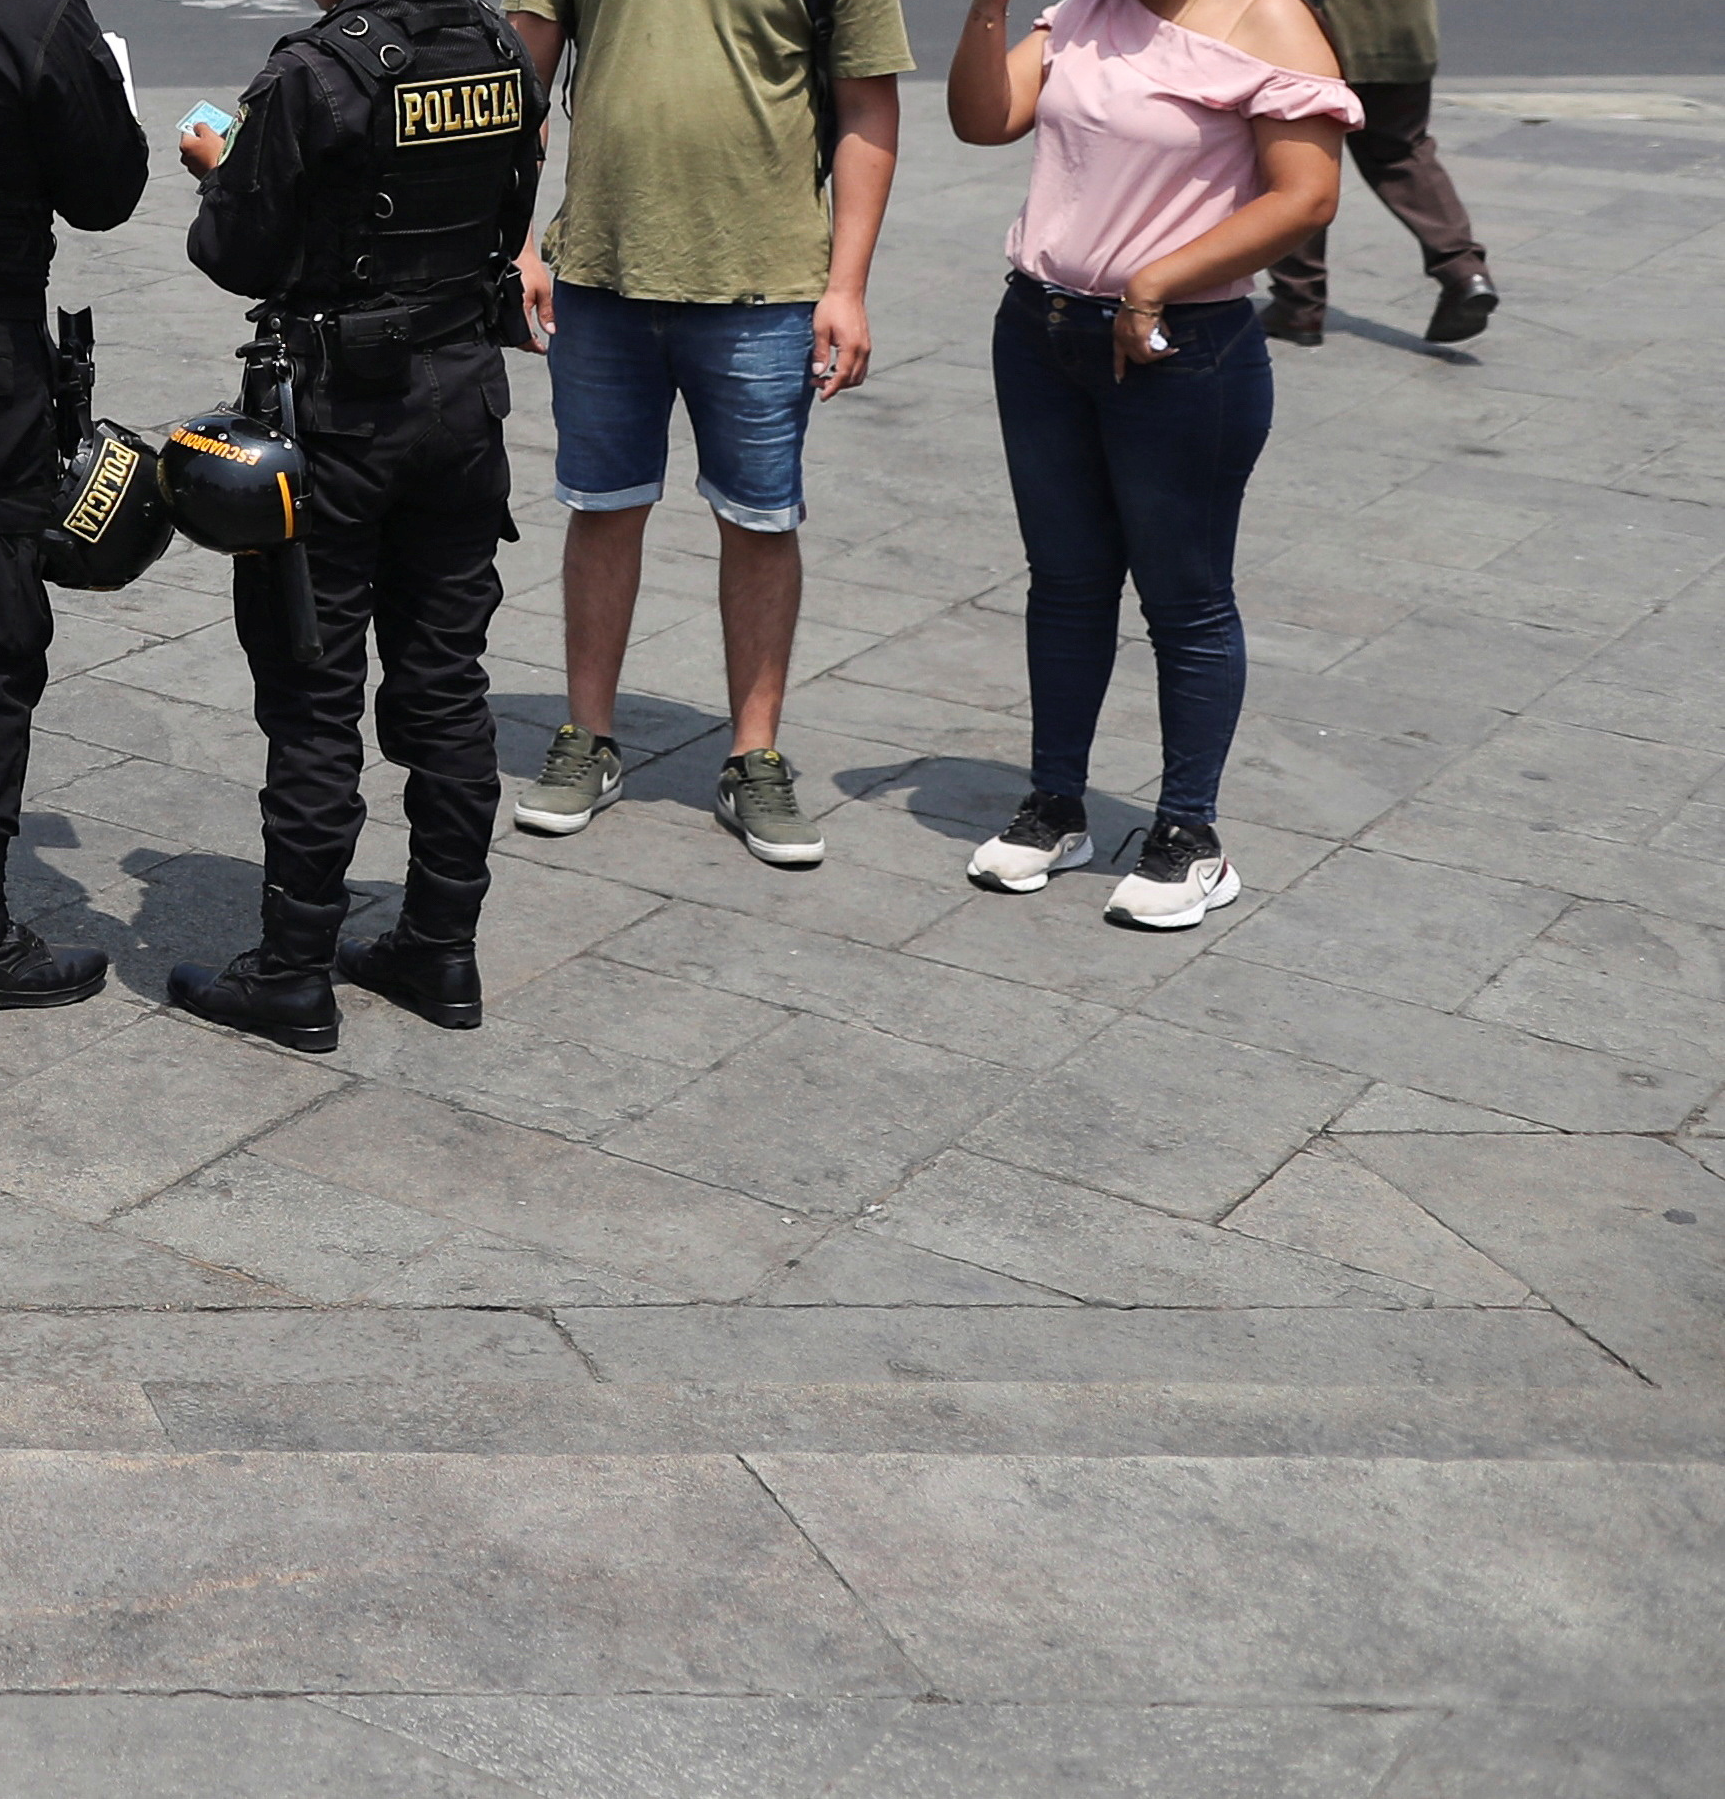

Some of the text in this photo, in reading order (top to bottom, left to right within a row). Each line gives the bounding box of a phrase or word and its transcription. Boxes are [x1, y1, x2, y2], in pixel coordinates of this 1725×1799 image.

[402, 80, 519, 136] POLICIA
[181, 431, 263, 466] ESCUADRON
[69, 443, 134, 533] POLICIA
